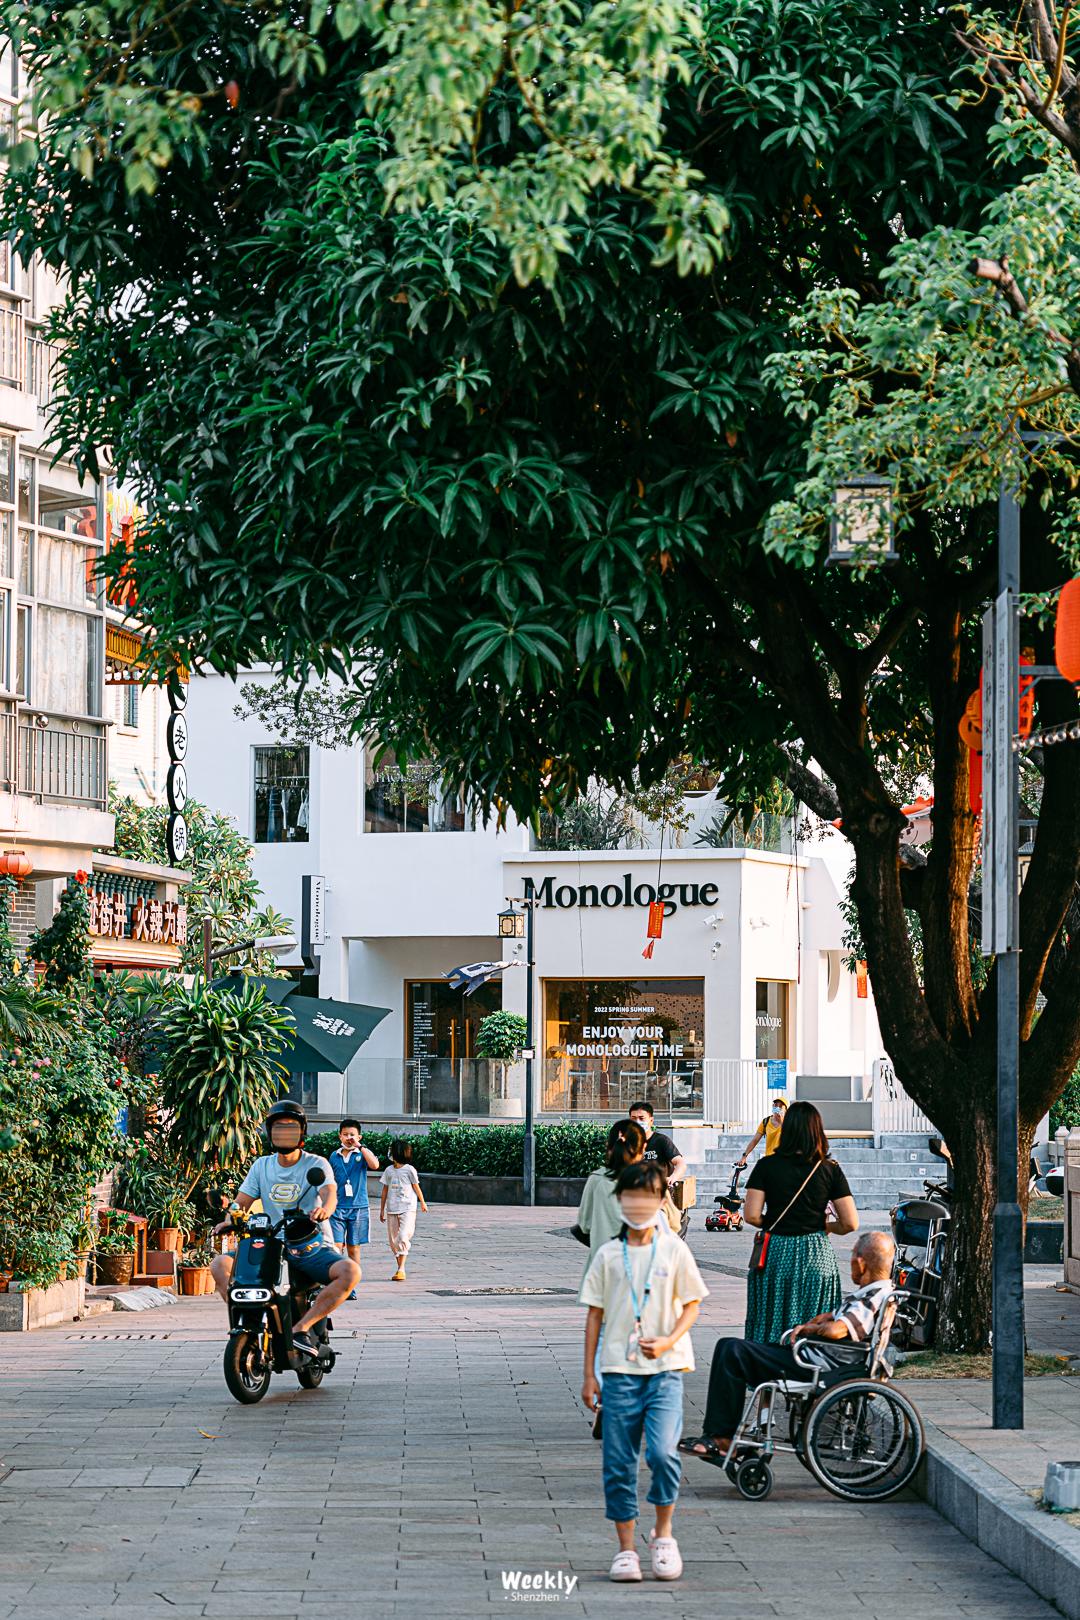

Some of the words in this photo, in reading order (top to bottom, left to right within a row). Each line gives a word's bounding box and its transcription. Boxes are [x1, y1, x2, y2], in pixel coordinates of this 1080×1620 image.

[521, 873, 719, 917] Monologue
[582, 1026, 625, 1039] ENJOY
[626, 1026, 664, 1039] YOUR
[566, 1044, 648, 1057] MONOLOGUE
[650, 1044, 684, 1057] TIME
